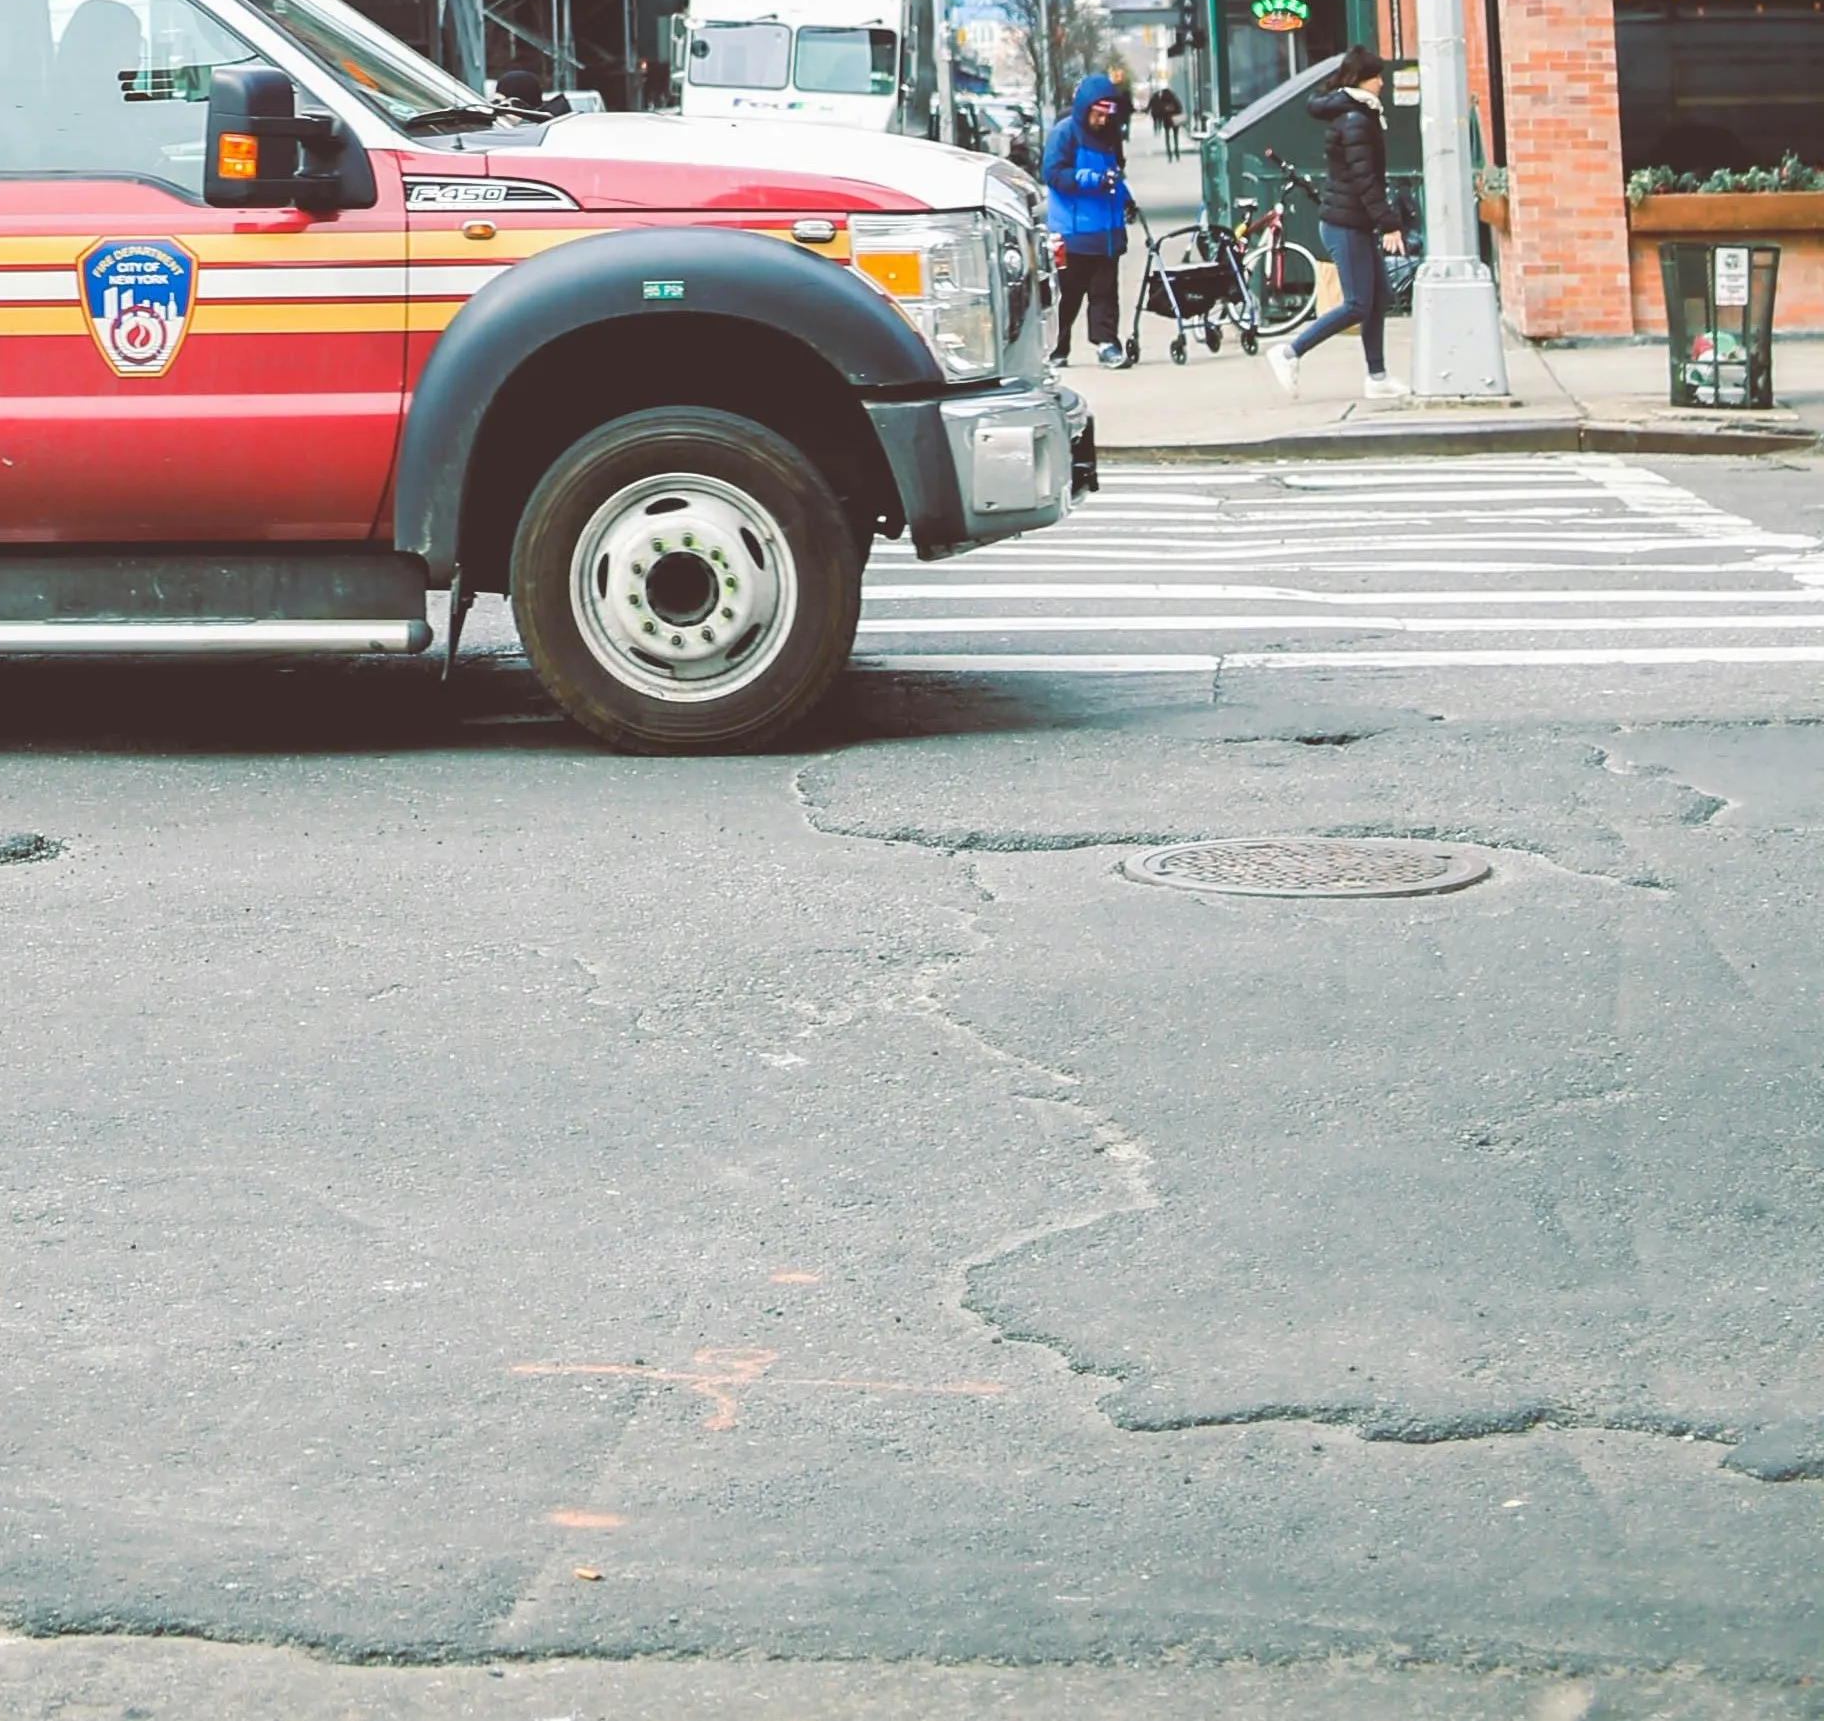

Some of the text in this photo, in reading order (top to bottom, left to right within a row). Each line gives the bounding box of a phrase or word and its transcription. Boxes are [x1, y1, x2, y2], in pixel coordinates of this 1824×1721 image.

[92, 245, 185, 278] FIRE DEPARTMENT
[116, 262, 161, 273] CITY OF
[108, 274, 169, 285] NEW YORK
